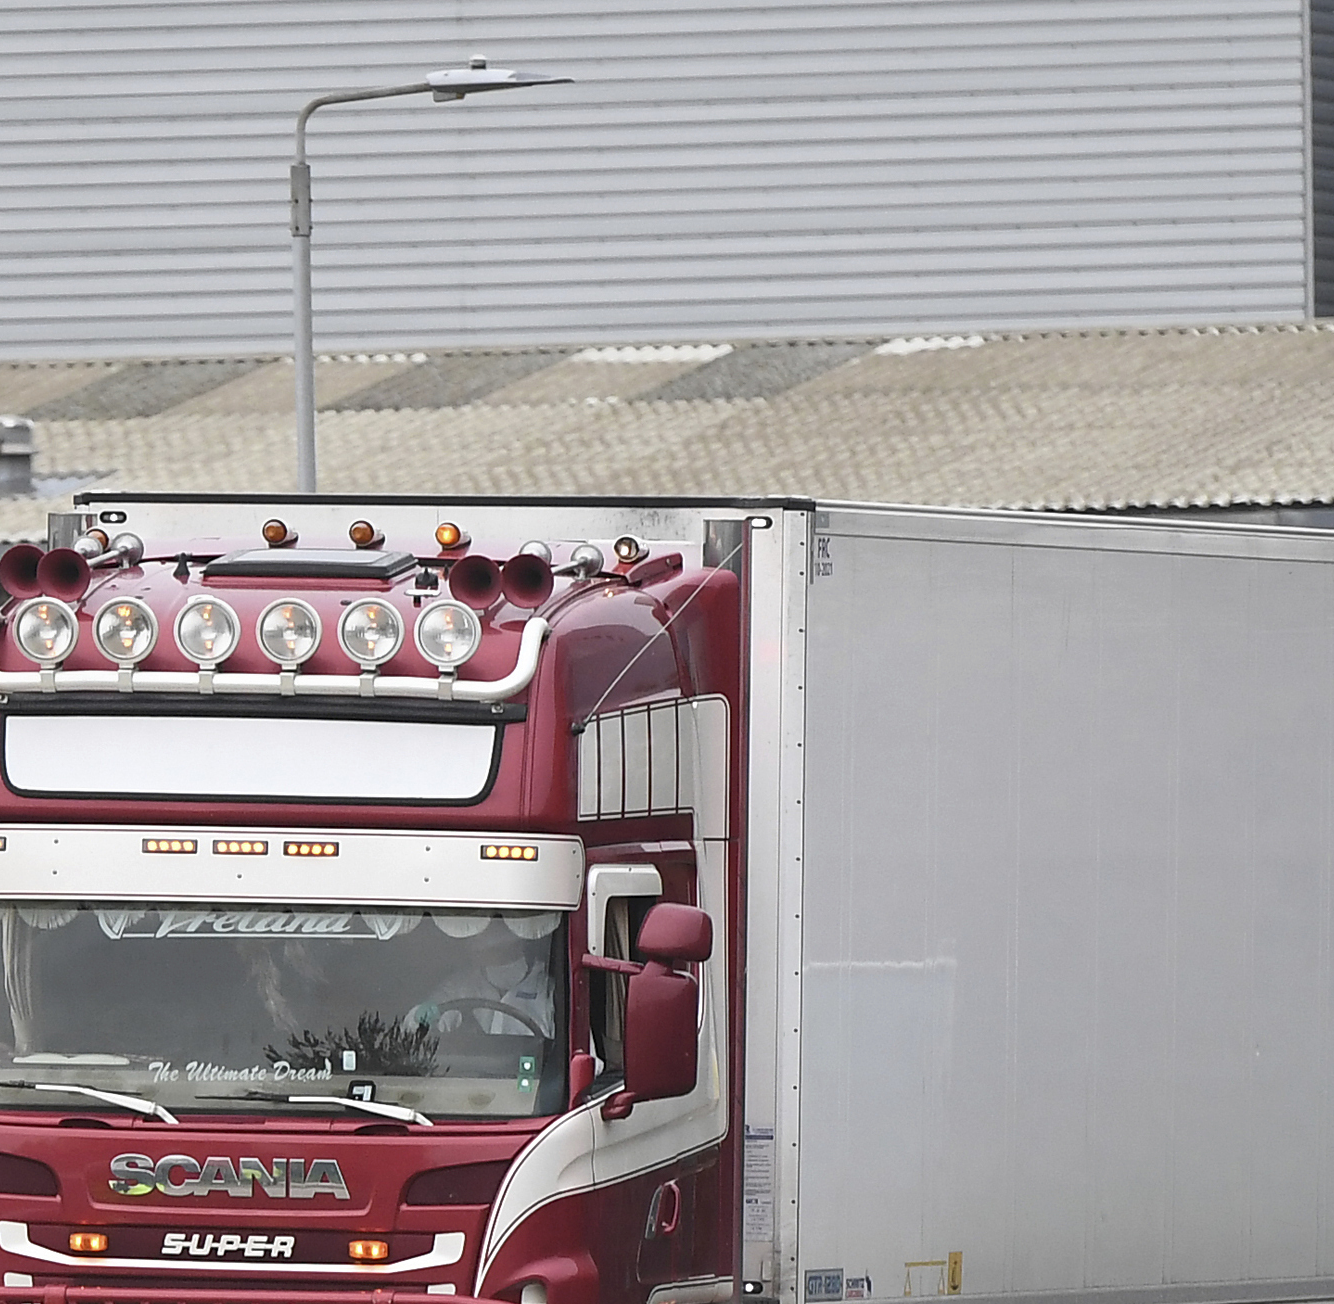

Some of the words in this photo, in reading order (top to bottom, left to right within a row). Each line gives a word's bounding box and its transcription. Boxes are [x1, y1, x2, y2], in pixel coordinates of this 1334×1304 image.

[148, 1061, 179, 1082] The
[185, 1060, 267, 1082] Ultimate
[273, 1059, 334, 1083] Dream
[108, 1153, 351, 1200] SCANIA
[161, 1233, 295, 1258] SUPER
